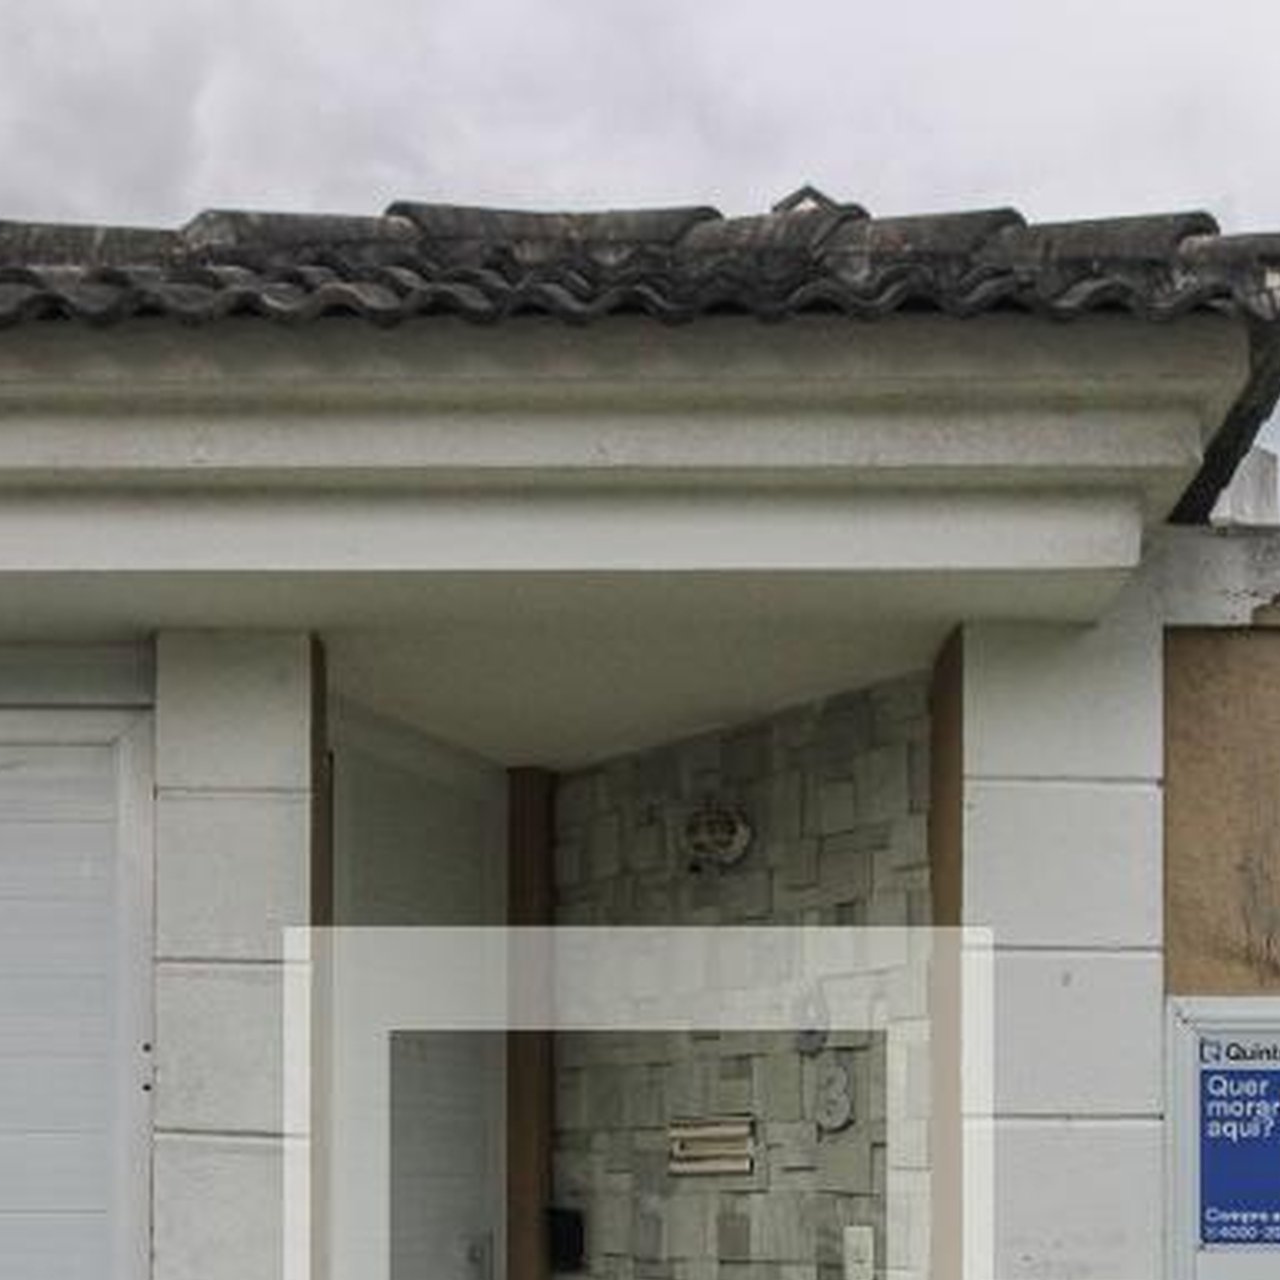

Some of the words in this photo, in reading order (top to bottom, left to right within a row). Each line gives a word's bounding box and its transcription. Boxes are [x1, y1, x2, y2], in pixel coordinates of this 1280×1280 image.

[1207, 1075, 1270, 1098] Quer
[1207, 1099, 1280, 1117] morar
[1207, 1117, 1275, 1142] aqui?
